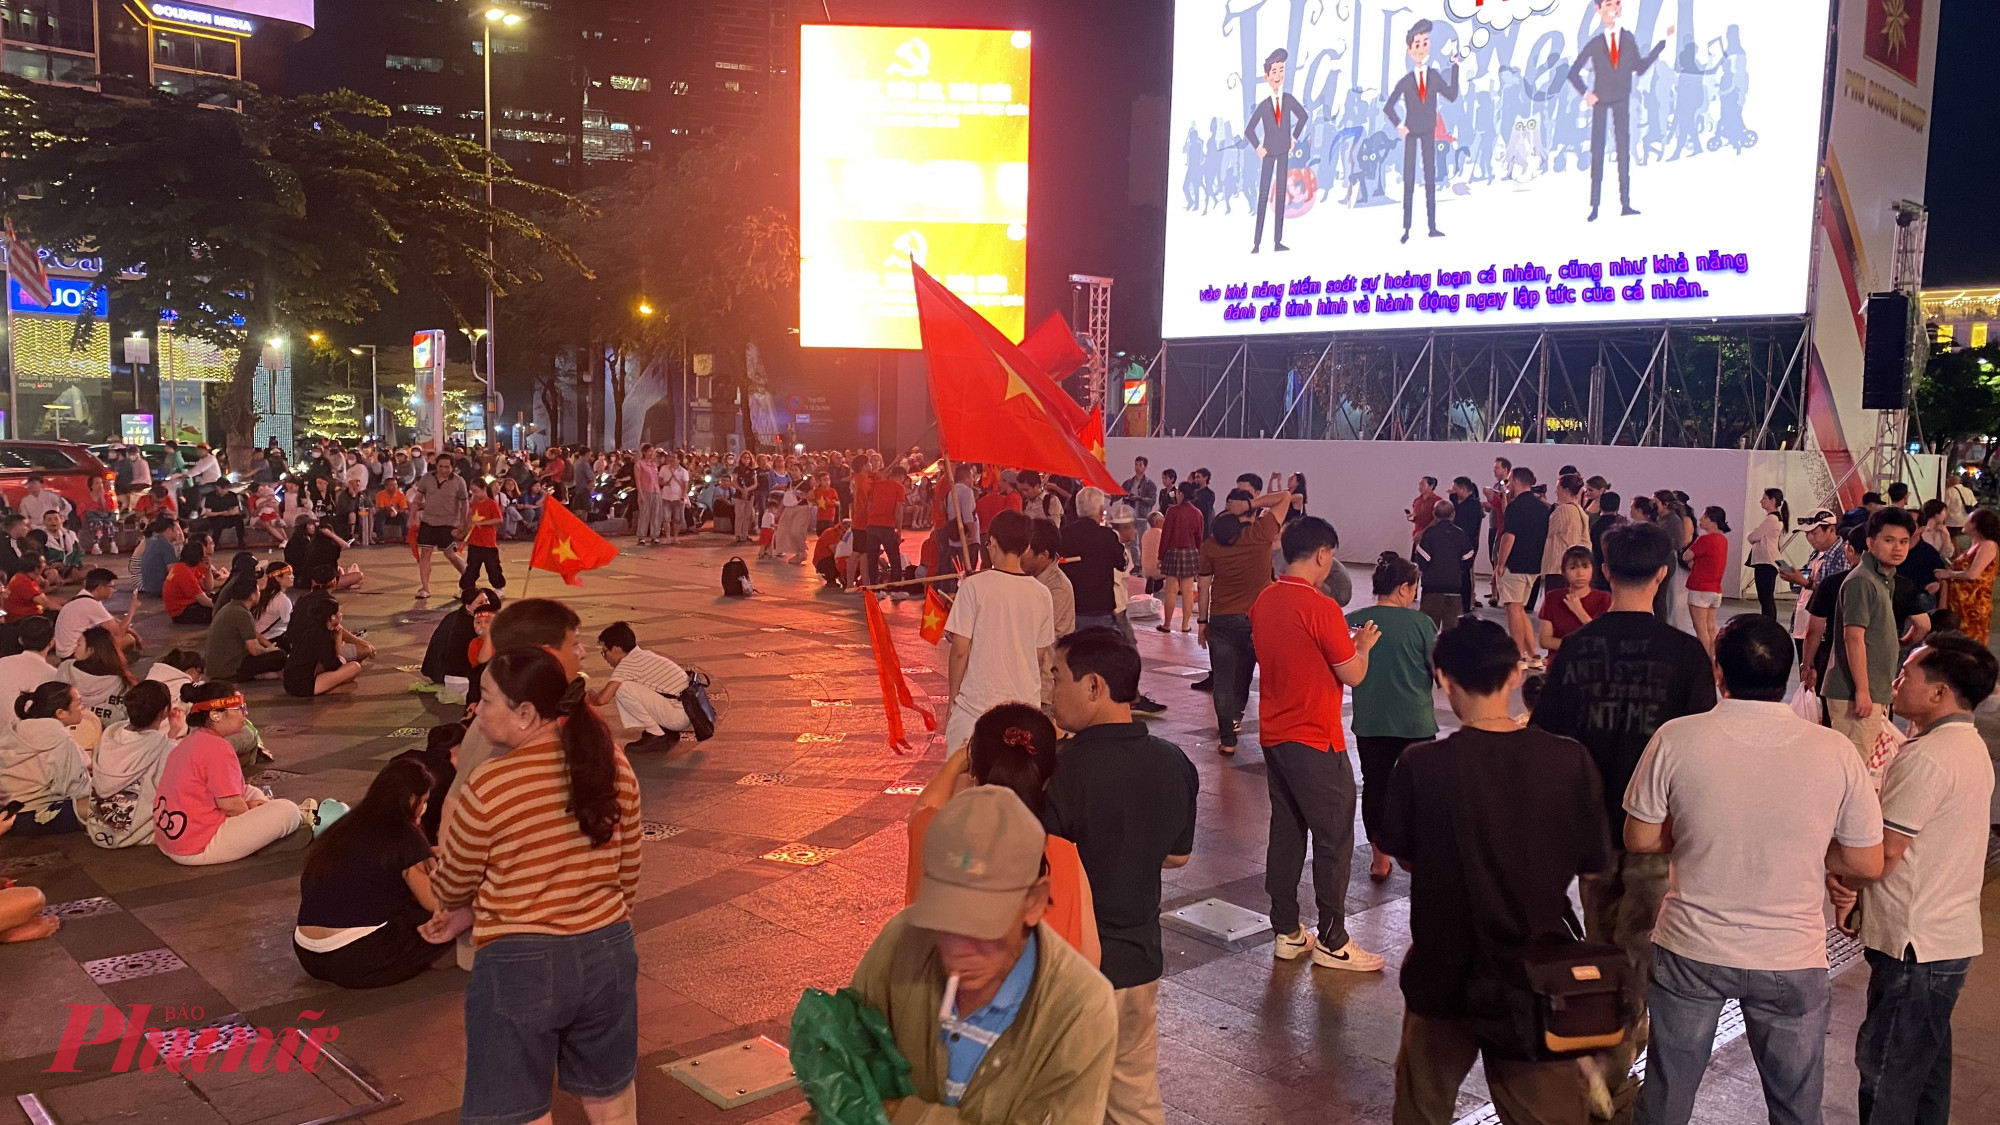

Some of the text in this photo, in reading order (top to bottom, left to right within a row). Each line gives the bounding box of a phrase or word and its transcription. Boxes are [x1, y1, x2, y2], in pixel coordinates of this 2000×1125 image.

[213, 14, 253, 32] MEDIA
[1326, 274, 1358, 293] soát
[1361, 274, 1381, 294] sự
[1384, 270, 1431, 290] hoảng
[1437, 268, 1471, 290] loạn
[1478, 264, 1497, 284] cá
[1503, 262, 1552, 284] nhân,
[1558, 259, 1602, 282] cũng
[1610, 256, 1648, 276] như
[1653, 252, 1689, 274] khả
[1697, 250, 1749, 273] năng
[1223, 276, 1709, 322] đánh giá tình hình và hành động ngay lập tức của cá nhân.
